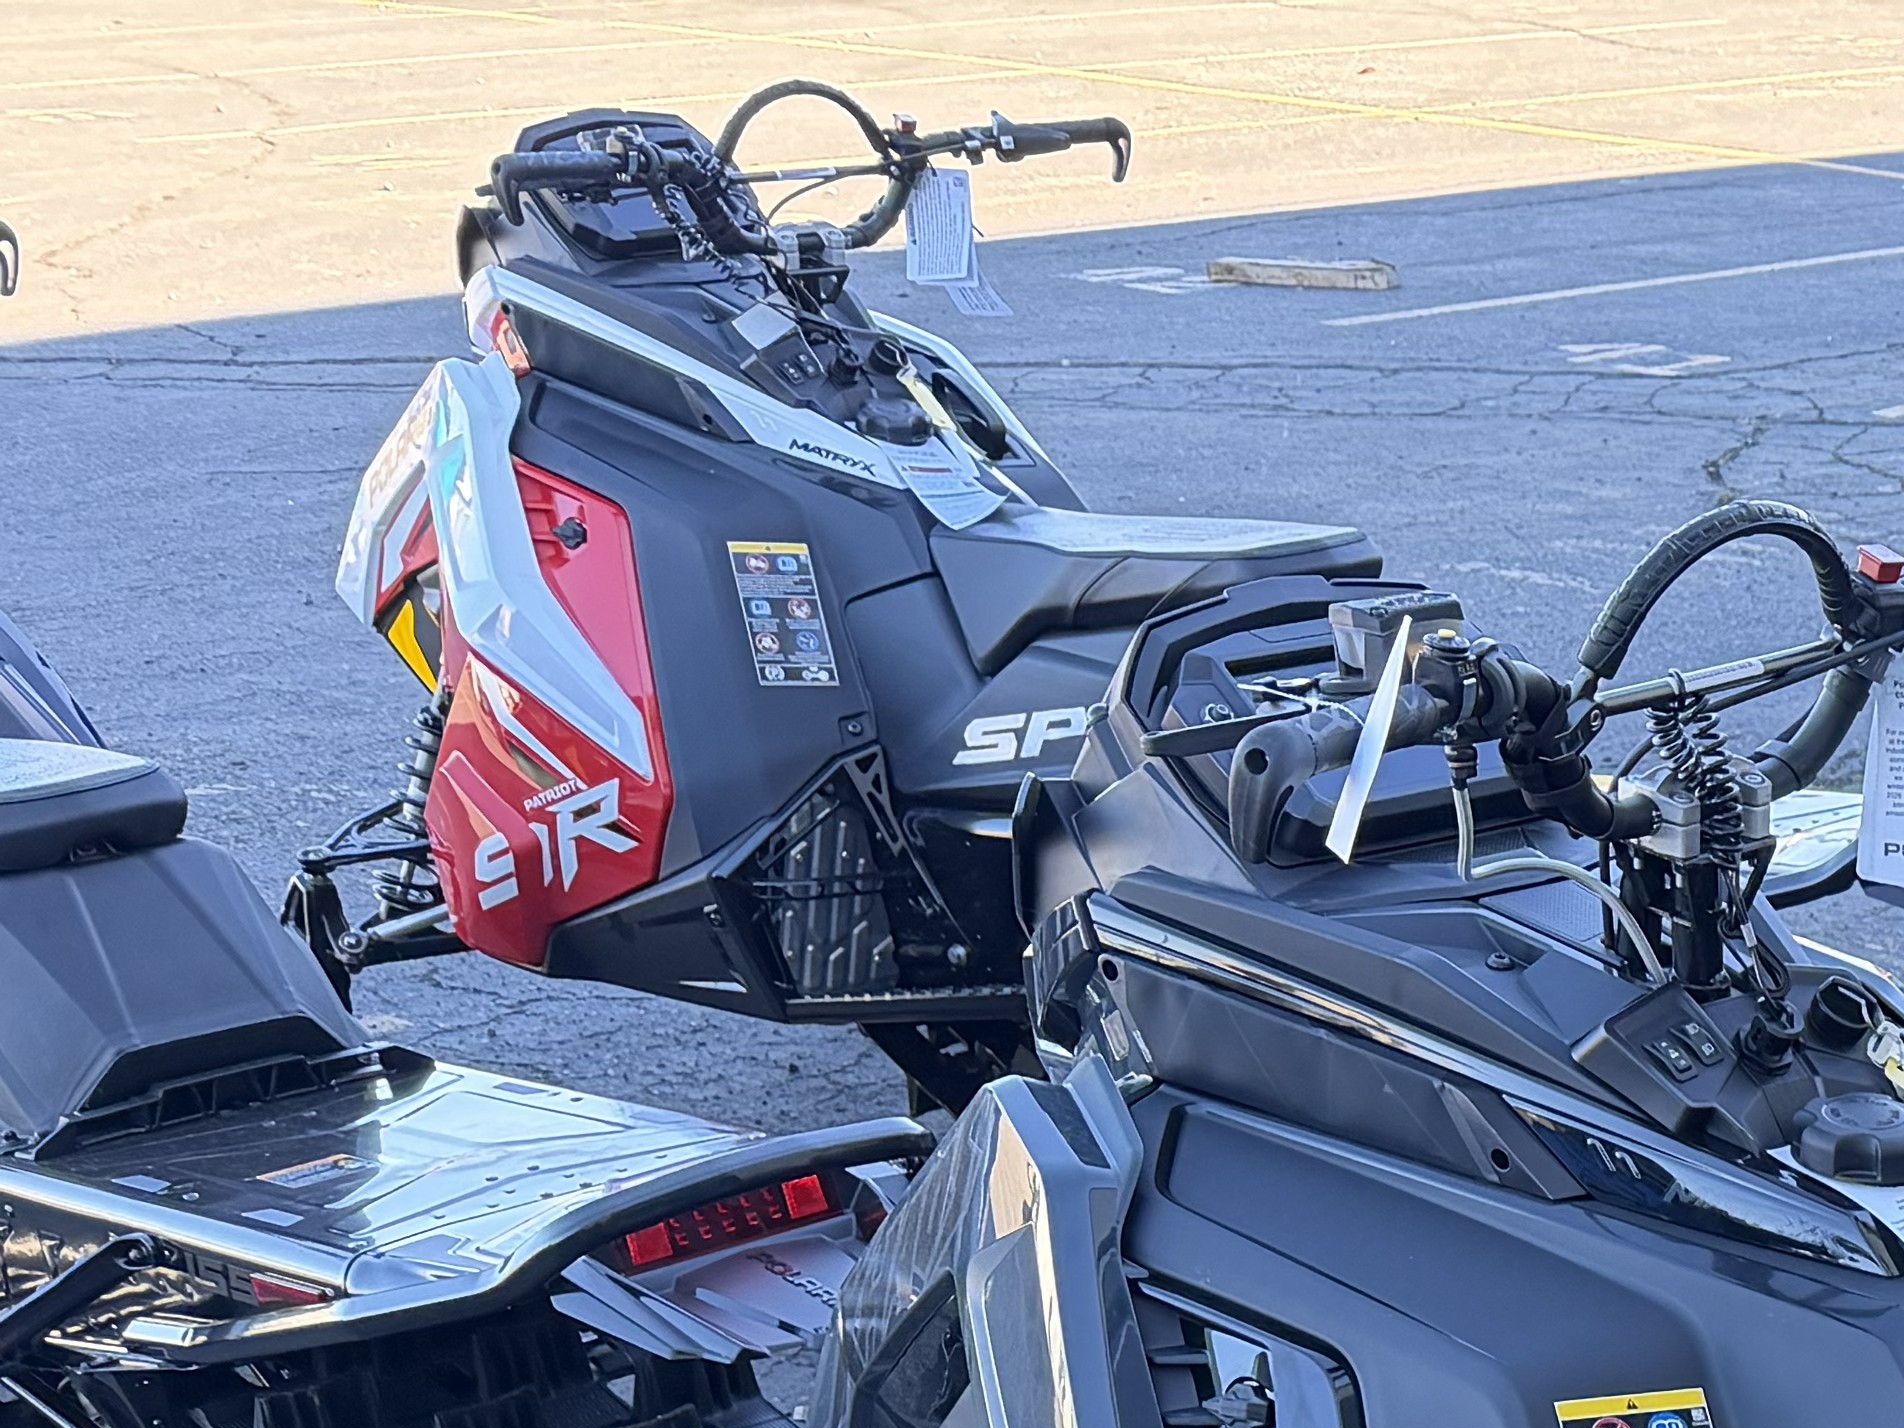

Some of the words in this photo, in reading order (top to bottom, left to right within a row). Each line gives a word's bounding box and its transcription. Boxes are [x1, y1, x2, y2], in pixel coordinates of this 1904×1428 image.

[788, 438, 876, 477] MATRYX
[952, 706, 1088, 765] SP
[523, 778, 578, 812] PATRIOT
